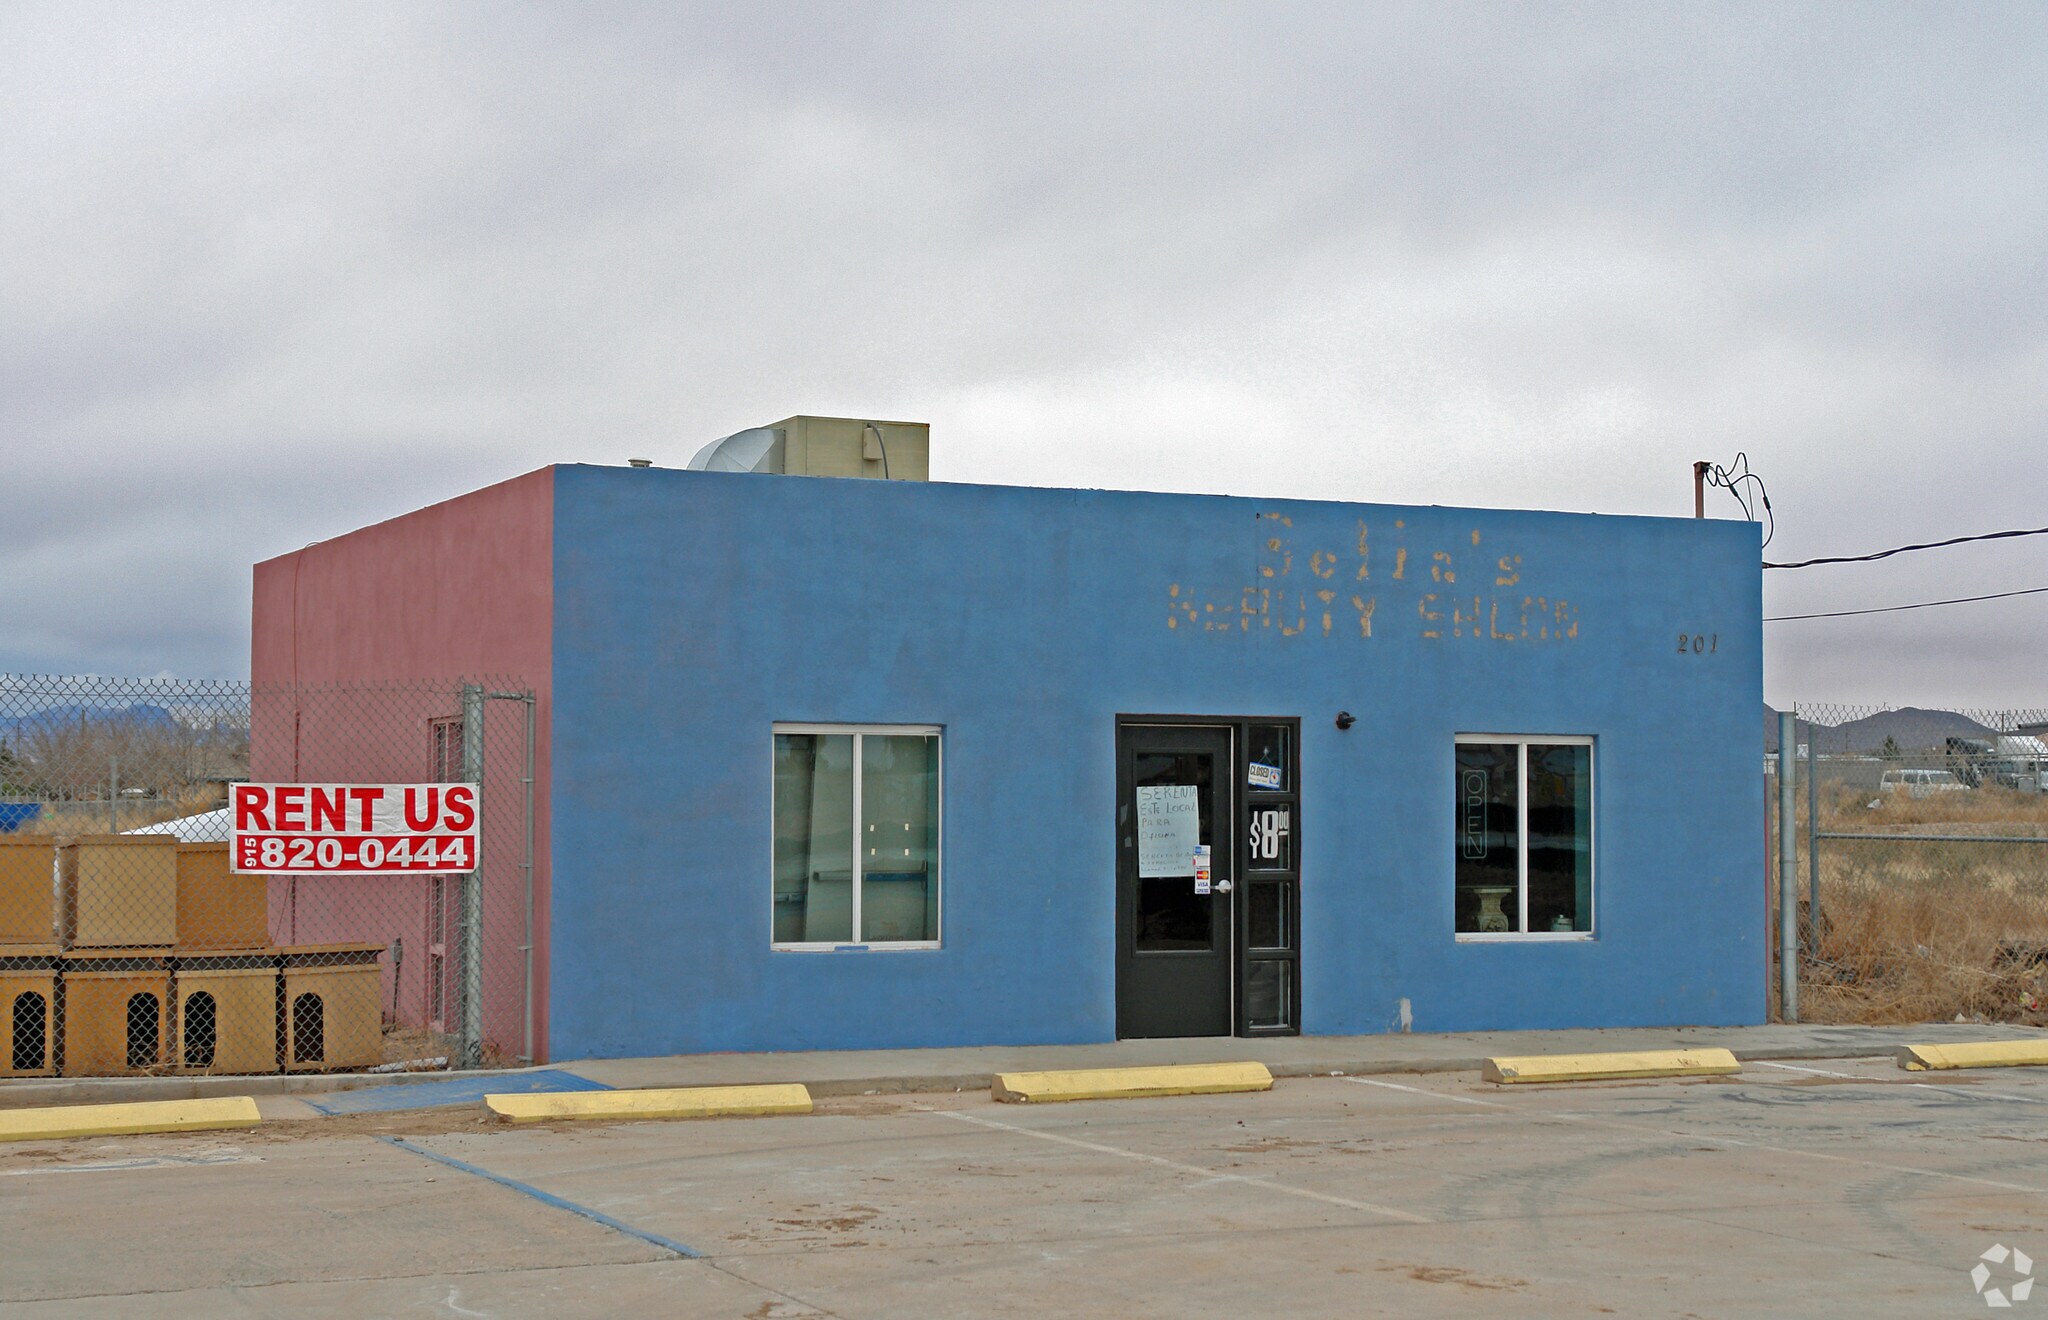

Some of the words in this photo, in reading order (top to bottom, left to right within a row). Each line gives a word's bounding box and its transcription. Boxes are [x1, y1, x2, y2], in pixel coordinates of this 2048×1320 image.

[1677, 632, 1717, 654] 201
[1249, 765, 1270, 778] CLOSED
[235, 786, 385, 832] RENT
[403, 786, 475, 832] US
[1466, 774, 1483, 855] OPEN
[244, 838, 257, 867] 915
[260, 837, 468, 868] 820-0444
